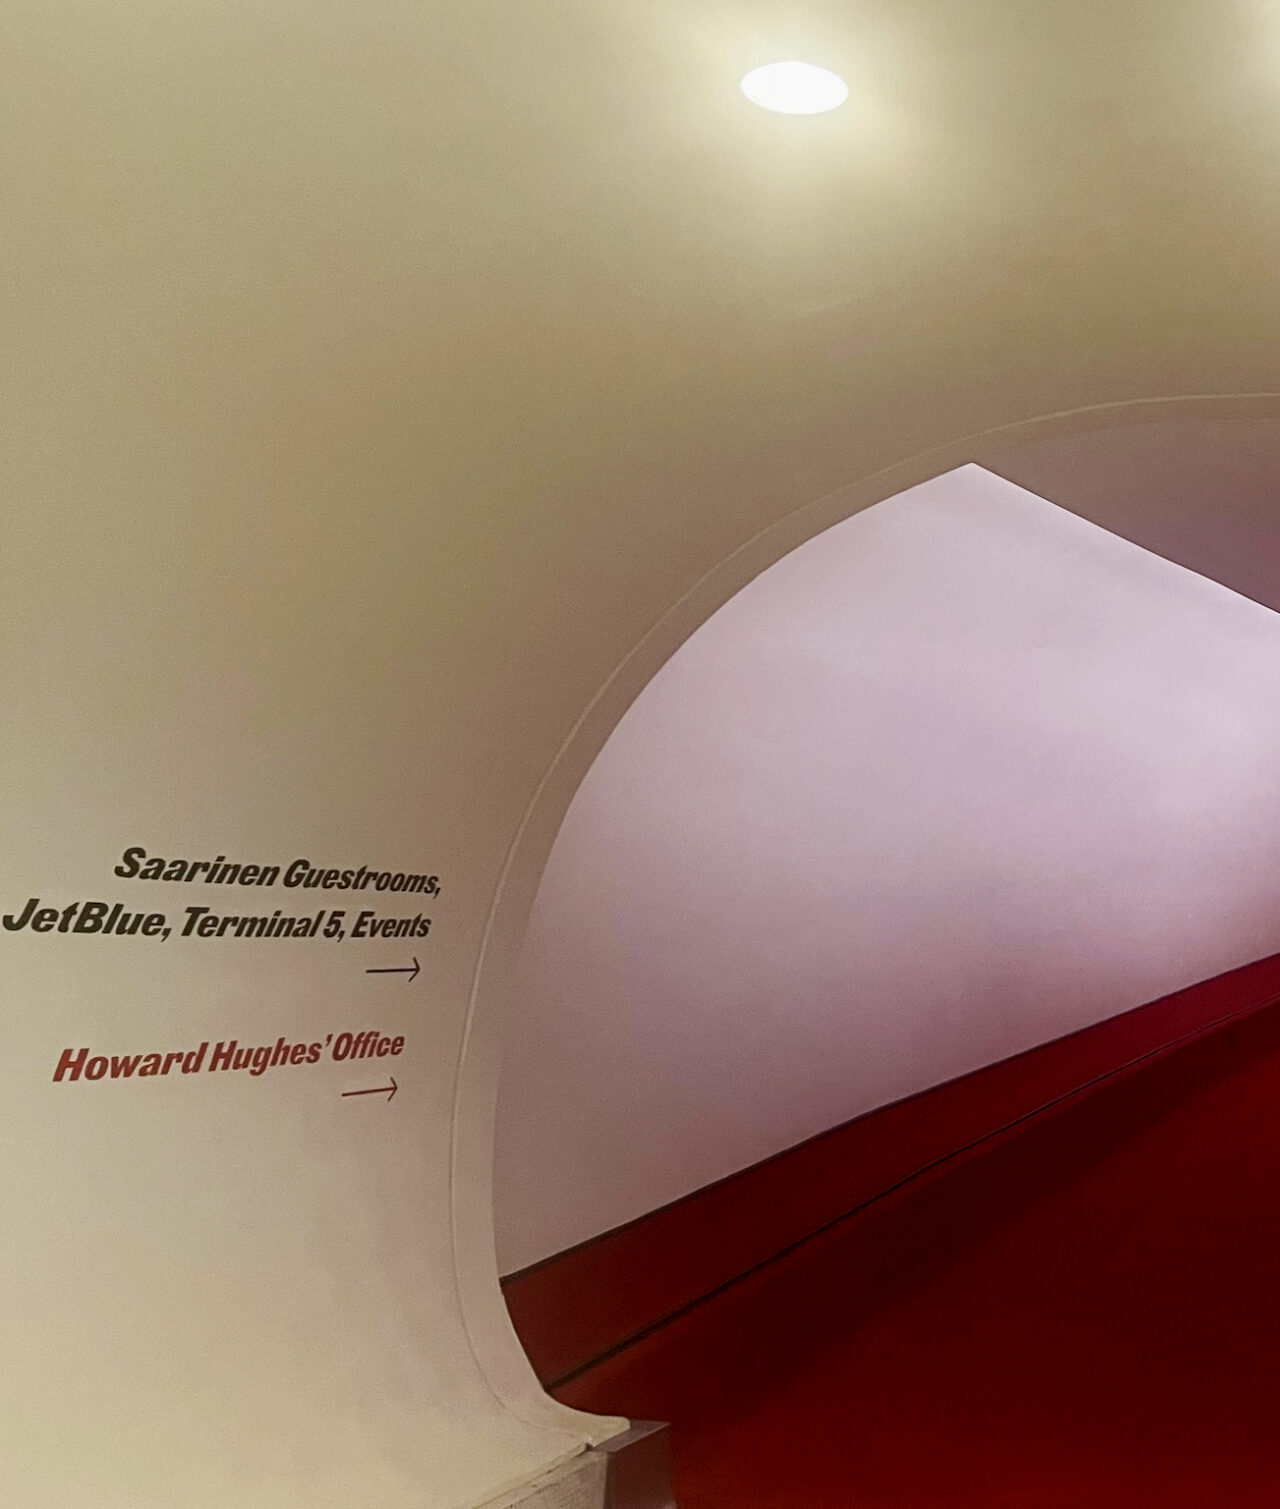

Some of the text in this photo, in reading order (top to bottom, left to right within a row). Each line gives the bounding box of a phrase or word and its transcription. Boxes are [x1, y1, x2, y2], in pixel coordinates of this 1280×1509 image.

[114, 847, 441, 899] Saarinen Guestrooms,
[2, 898, 432, 943] JetBlue, Terminal 5, Events
[52, 1042, 210, 1082] Howard
[332, 1030, 405, 1062] Office
